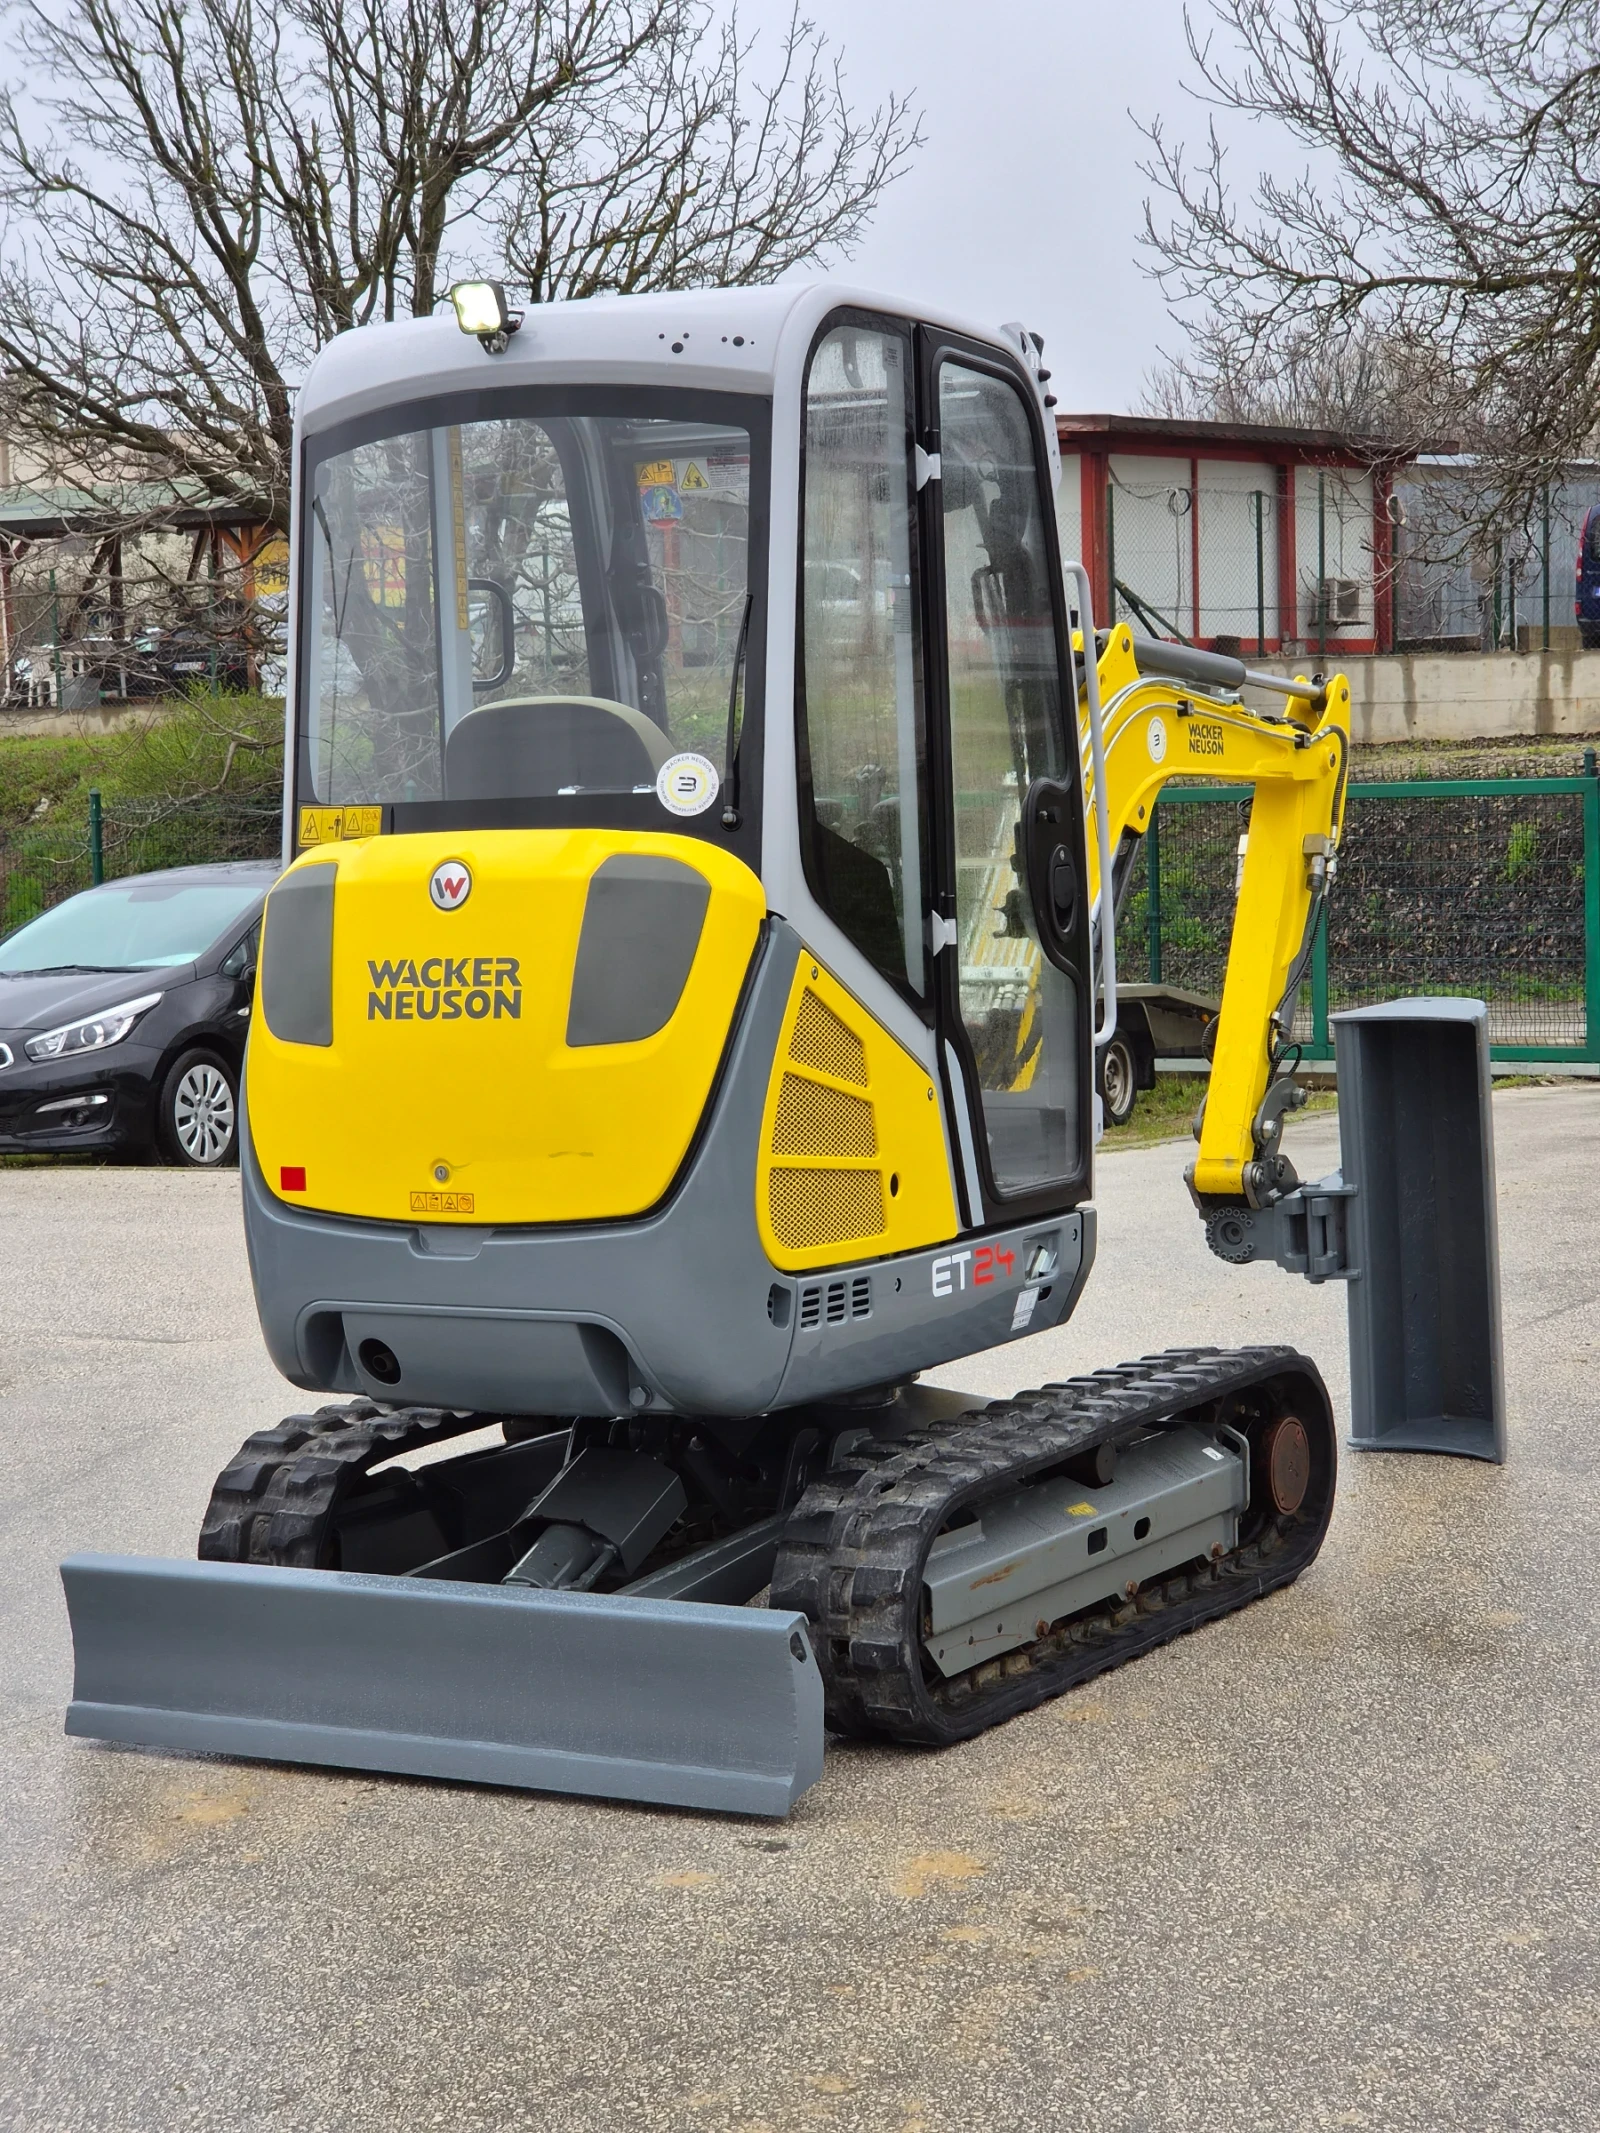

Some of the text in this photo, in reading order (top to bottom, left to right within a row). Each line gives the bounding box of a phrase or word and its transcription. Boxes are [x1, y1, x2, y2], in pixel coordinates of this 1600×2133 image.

[1188, 723, 1224, 740] WACKER
[1189, 739, 1224, 755] NEUSON
[666, 756, 712, 773] WACKER NEUSON
[434, 877, 467, 900] W
[367, 957, 523, 989] WACKER
[367, 989, 522, 1021] NEUSON
